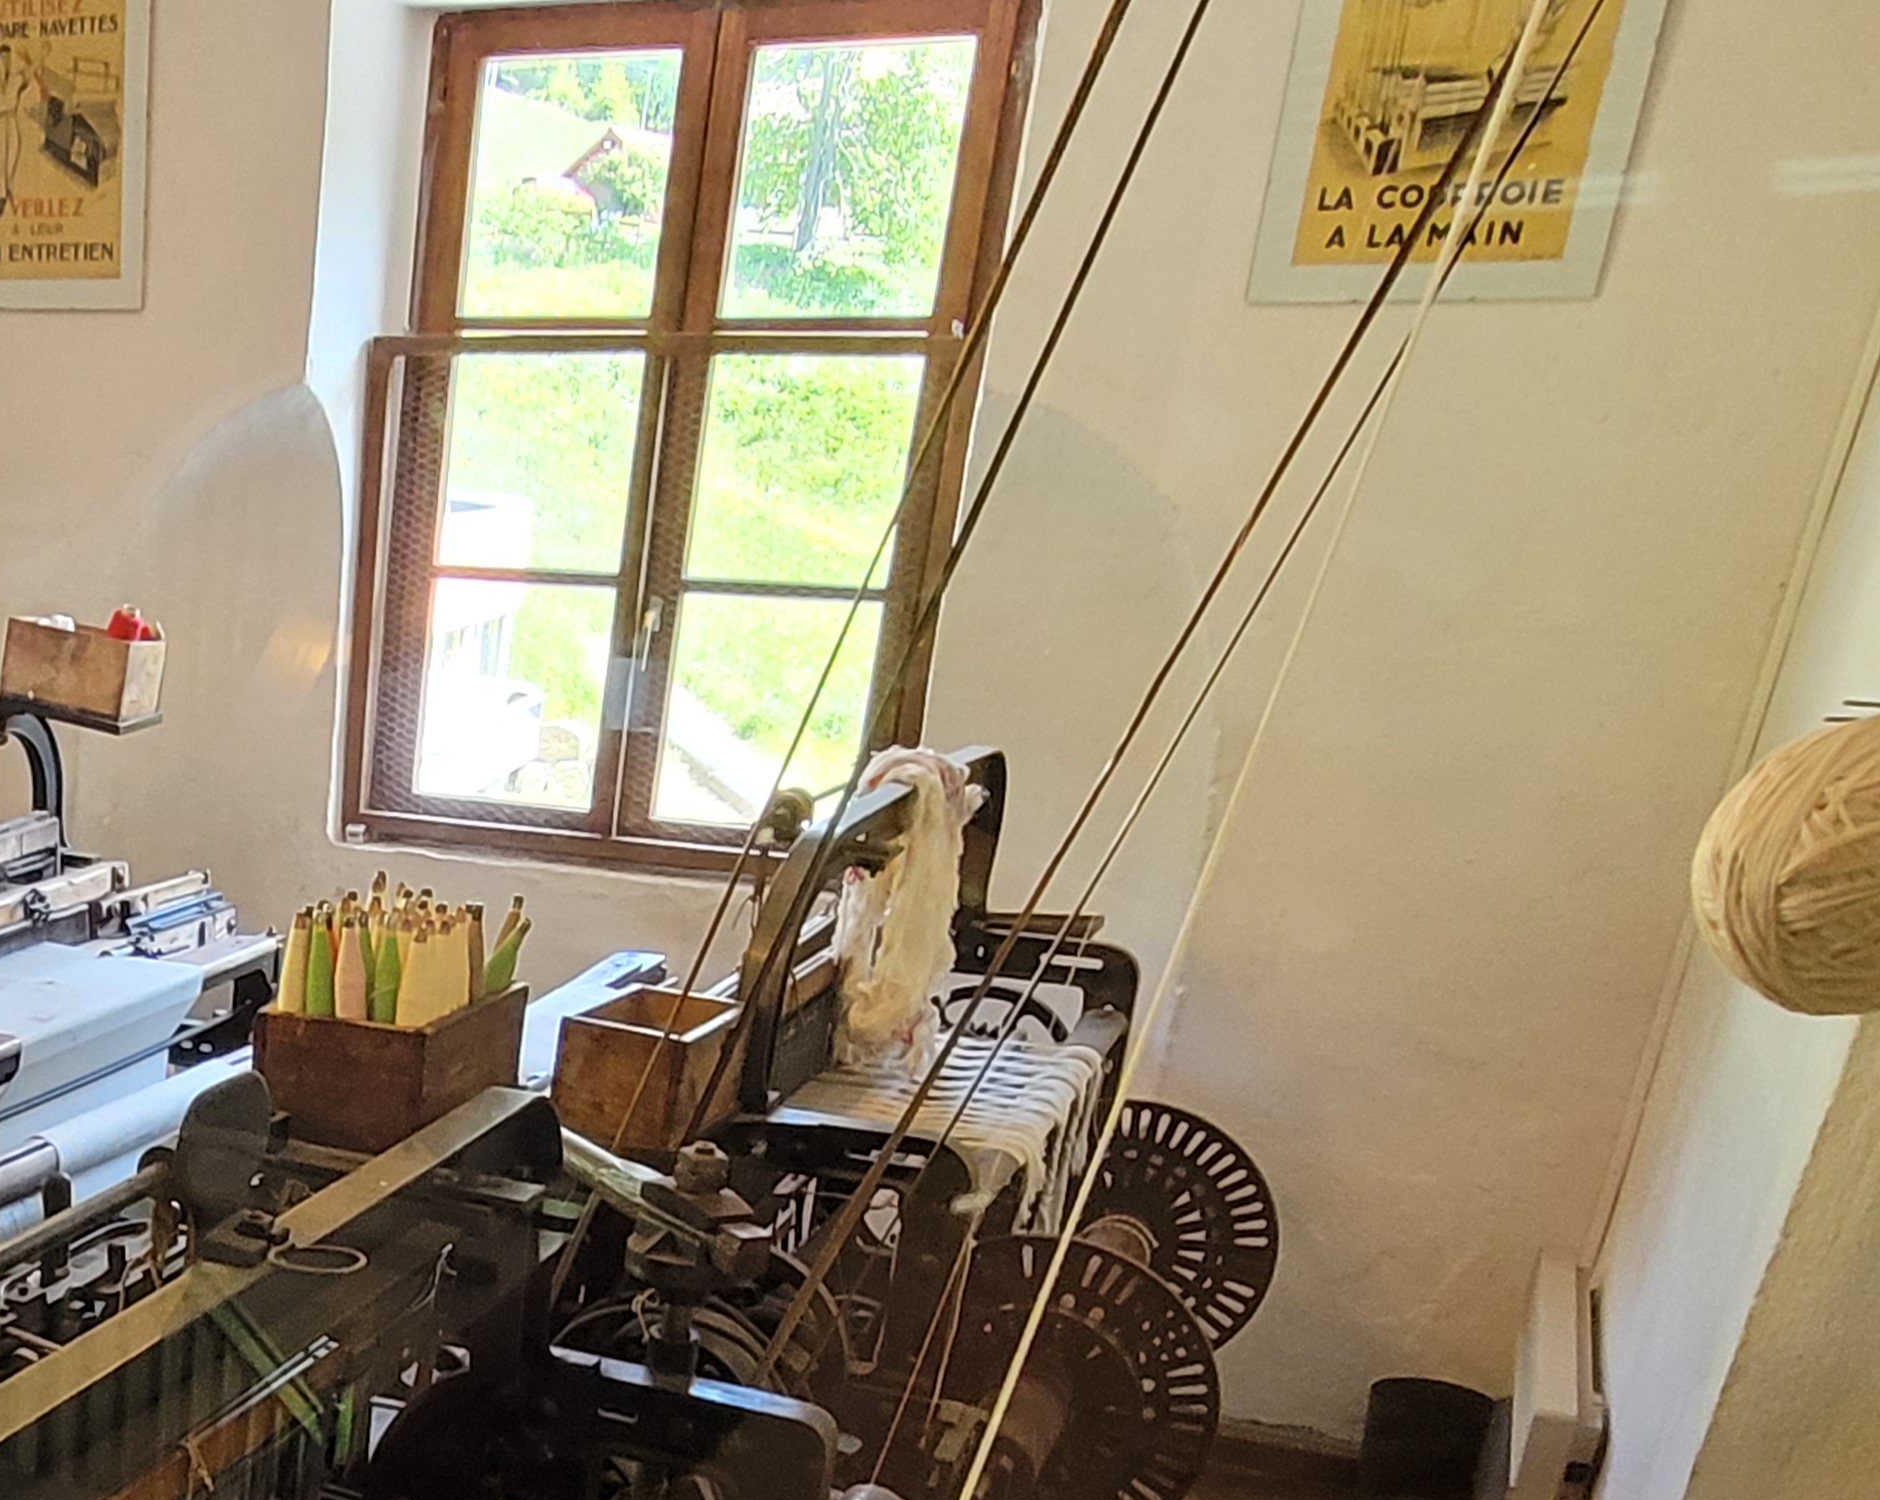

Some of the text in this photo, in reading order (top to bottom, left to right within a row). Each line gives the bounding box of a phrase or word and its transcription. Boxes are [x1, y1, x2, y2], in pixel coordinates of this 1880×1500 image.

[39, 14, 118, 36] NAVETTES
[1318, 186, 1353, 211] LA
[1325, 220, 1524, 248] A LA MAIN
[8, 241, 113, 262] ENTRETIEN
